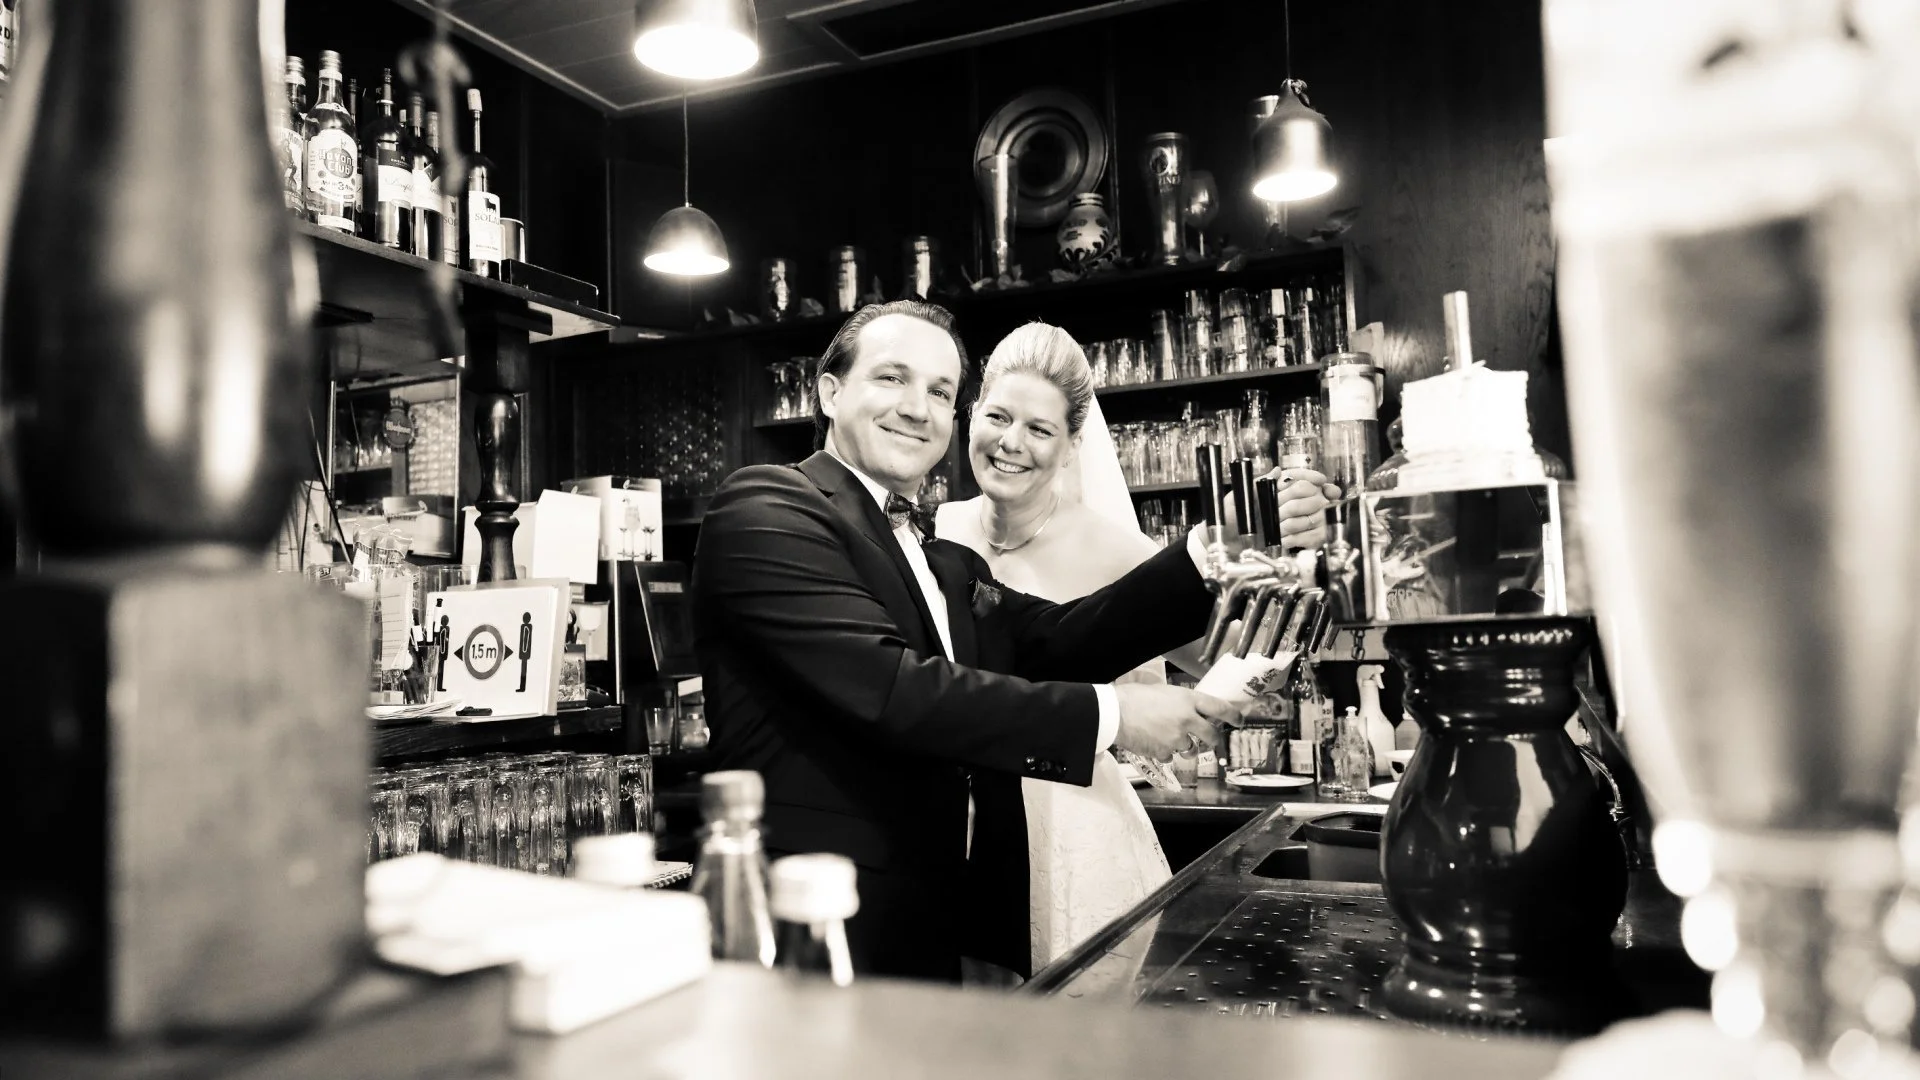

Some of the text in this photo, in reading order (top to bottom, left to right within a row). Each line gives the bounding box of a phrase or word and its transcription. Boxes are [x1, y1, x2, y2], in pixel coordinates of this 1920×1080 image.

[327, 160, 352, 176] Club
[472, 643, 497, 660] 1,5 m
